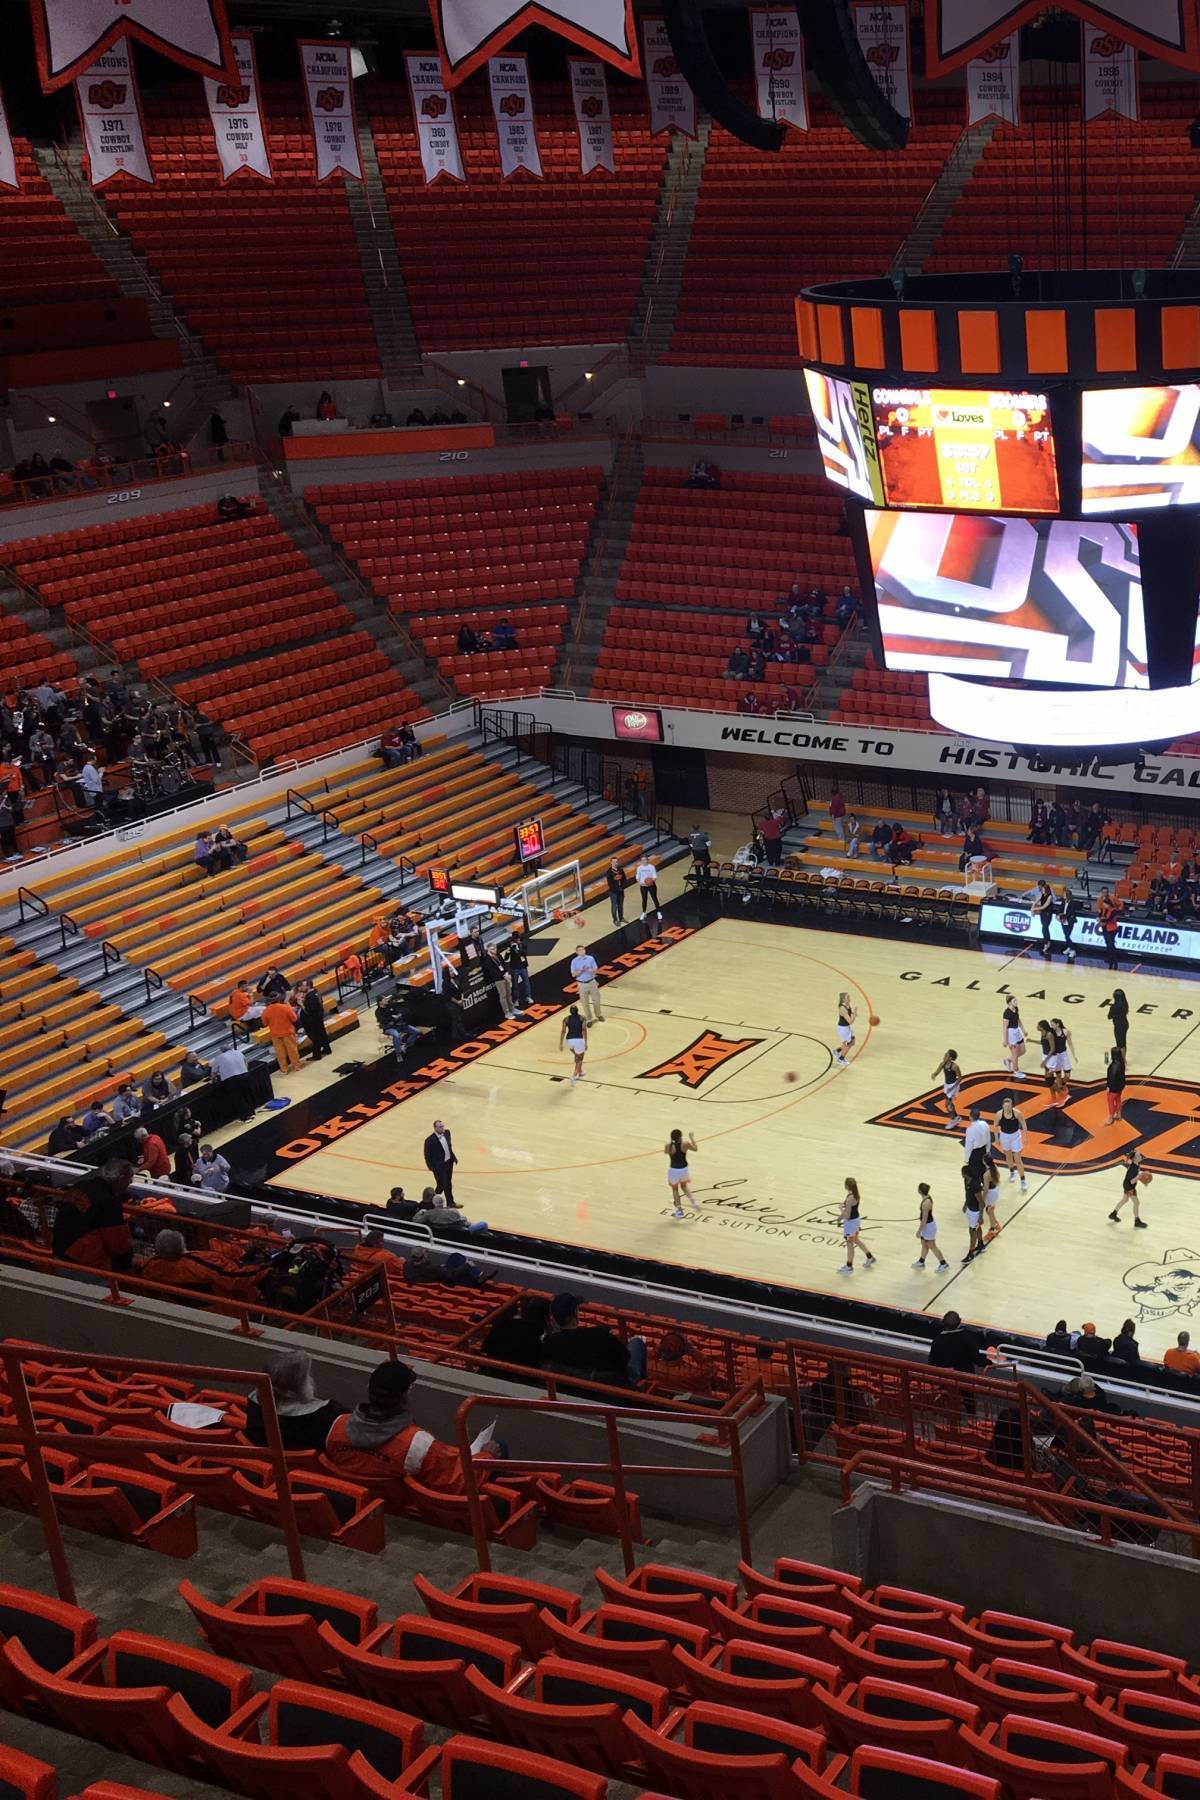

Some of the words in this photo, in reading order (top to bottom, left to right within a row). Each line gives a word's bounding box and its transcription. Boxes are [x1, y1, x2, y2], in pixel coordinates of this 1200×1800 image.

[756, 29, 798, 38] CHAMPIONS
[315, 52, 338, 62] NCAA
[307, 65, 347, 76] CHAMPIONS
[499, 63, 518, 72] NCAA
[492, 75, 526, 84] CHAMPIONS
[982, 72, 1003, 82] 1994
[101, 120, 125, 132] 1971
[227, 119, 249, 129] 1976
[324, 122, 342, 132] 1978
[100, 135, 130, 144] COWBOY
[226, 133, 253, 141] COWBOY
[323, 135, 346, 143] COWBOY
[101, 145, 134, 153] WRESTLING
[235, 142, 248, 150] GOLF
[952, 411, 984, 424] Loves
[854, 386, 877, 461] Hertz
[879, 425, 894, 436] PL
[902, 426, 910, 436] F
[918, 427, 933, 438] PT
[994, 430, 1008, 440] PL
[1017, 430, 1025, 441] F
[1034, 431, 1050, 441] PT
[440, 451, 469, 461] 210
[769, 449, 788, 458] 211
[106, 489, 141, 504] 209
[721, 726, 849, 752] WELCOME
[861, 740, 895, 756] TO
[1005, 915, 1031, 925] BEDLAM
[275, 1001, 563, 1159] OKLAHOMA
[719, 1218, 793, 1238] SUTTON
[1143, 1308, 1165, 1317] OSU
